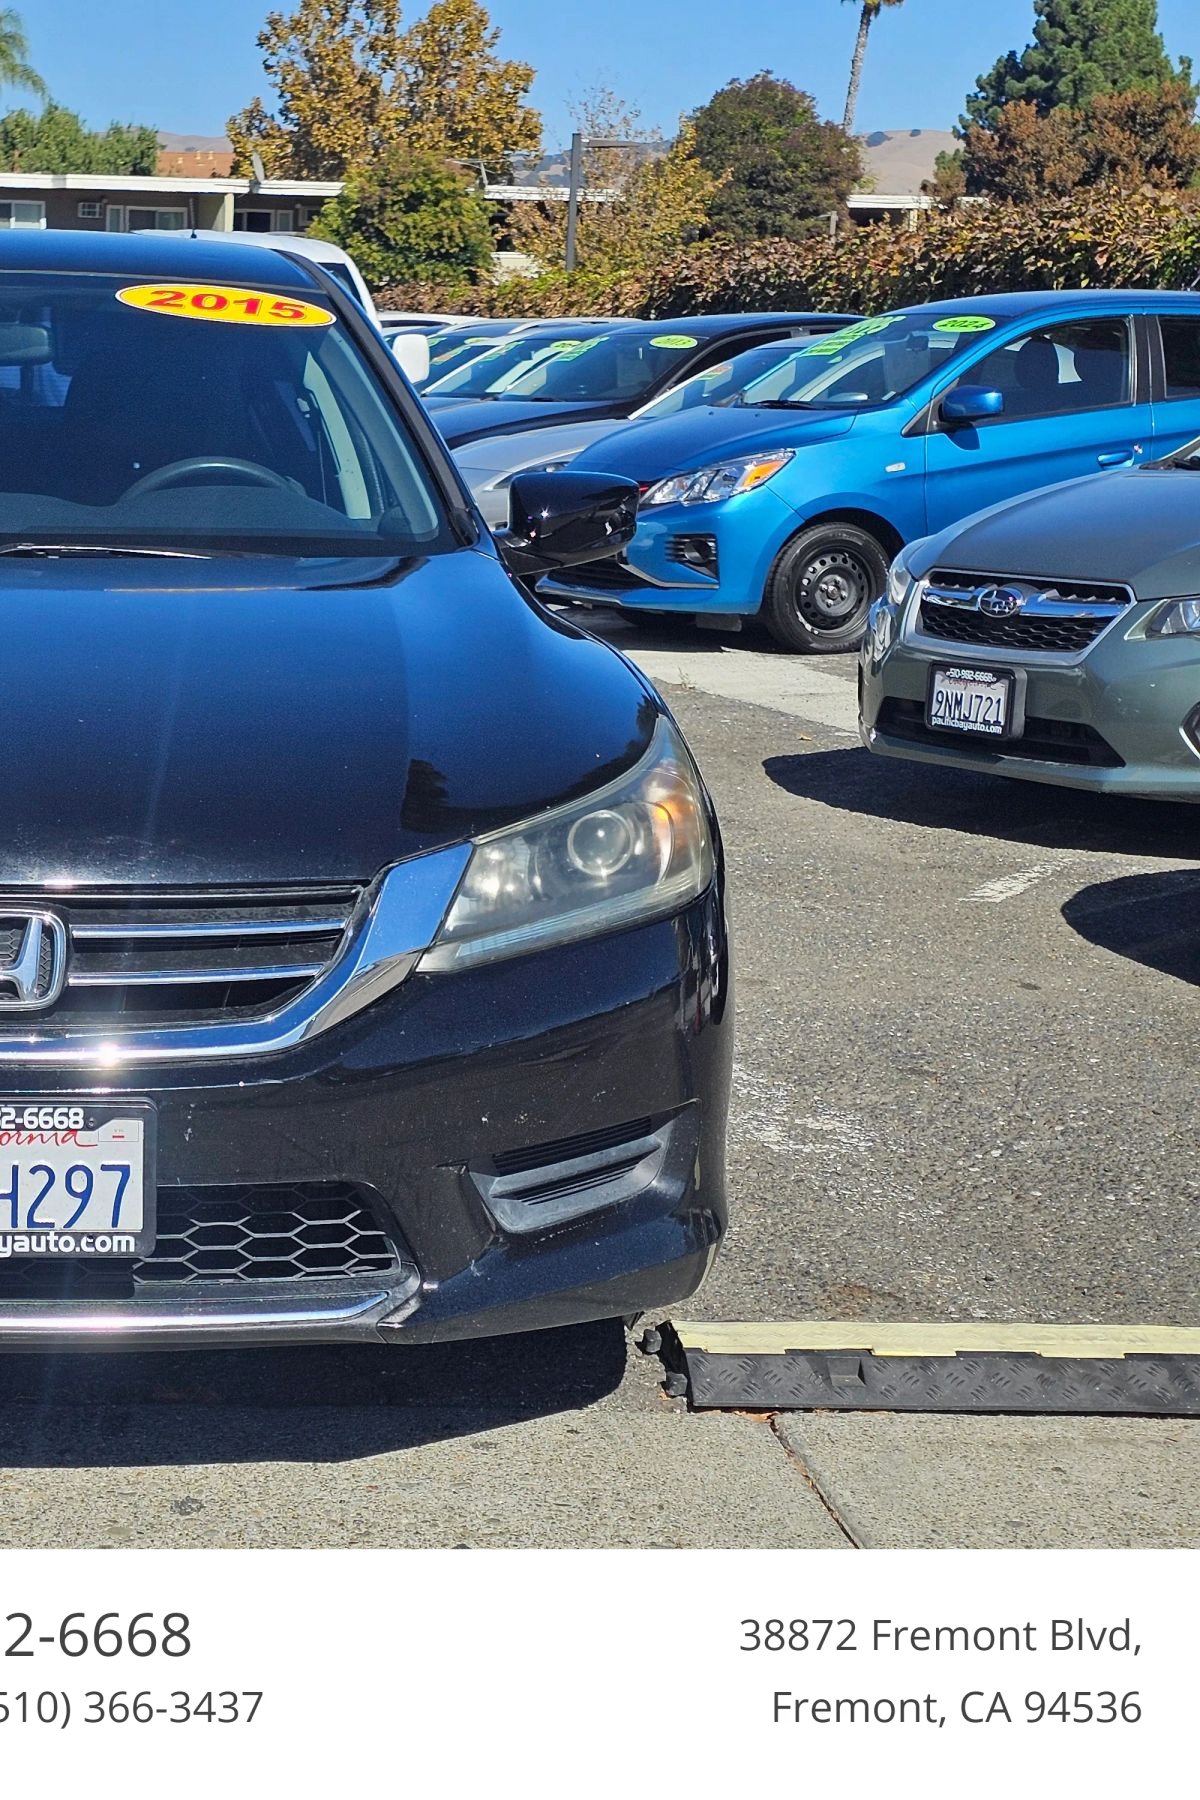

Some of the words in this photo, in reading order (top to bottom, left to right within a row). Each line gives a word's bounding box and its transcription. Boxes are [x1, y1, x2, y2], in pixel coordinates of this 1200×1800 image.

[145, 290, 306, 320] 2015
[934, 690, 1002, 724] 9NMJ721
[931, 716, 1003, 735] pacificbayauto.com
